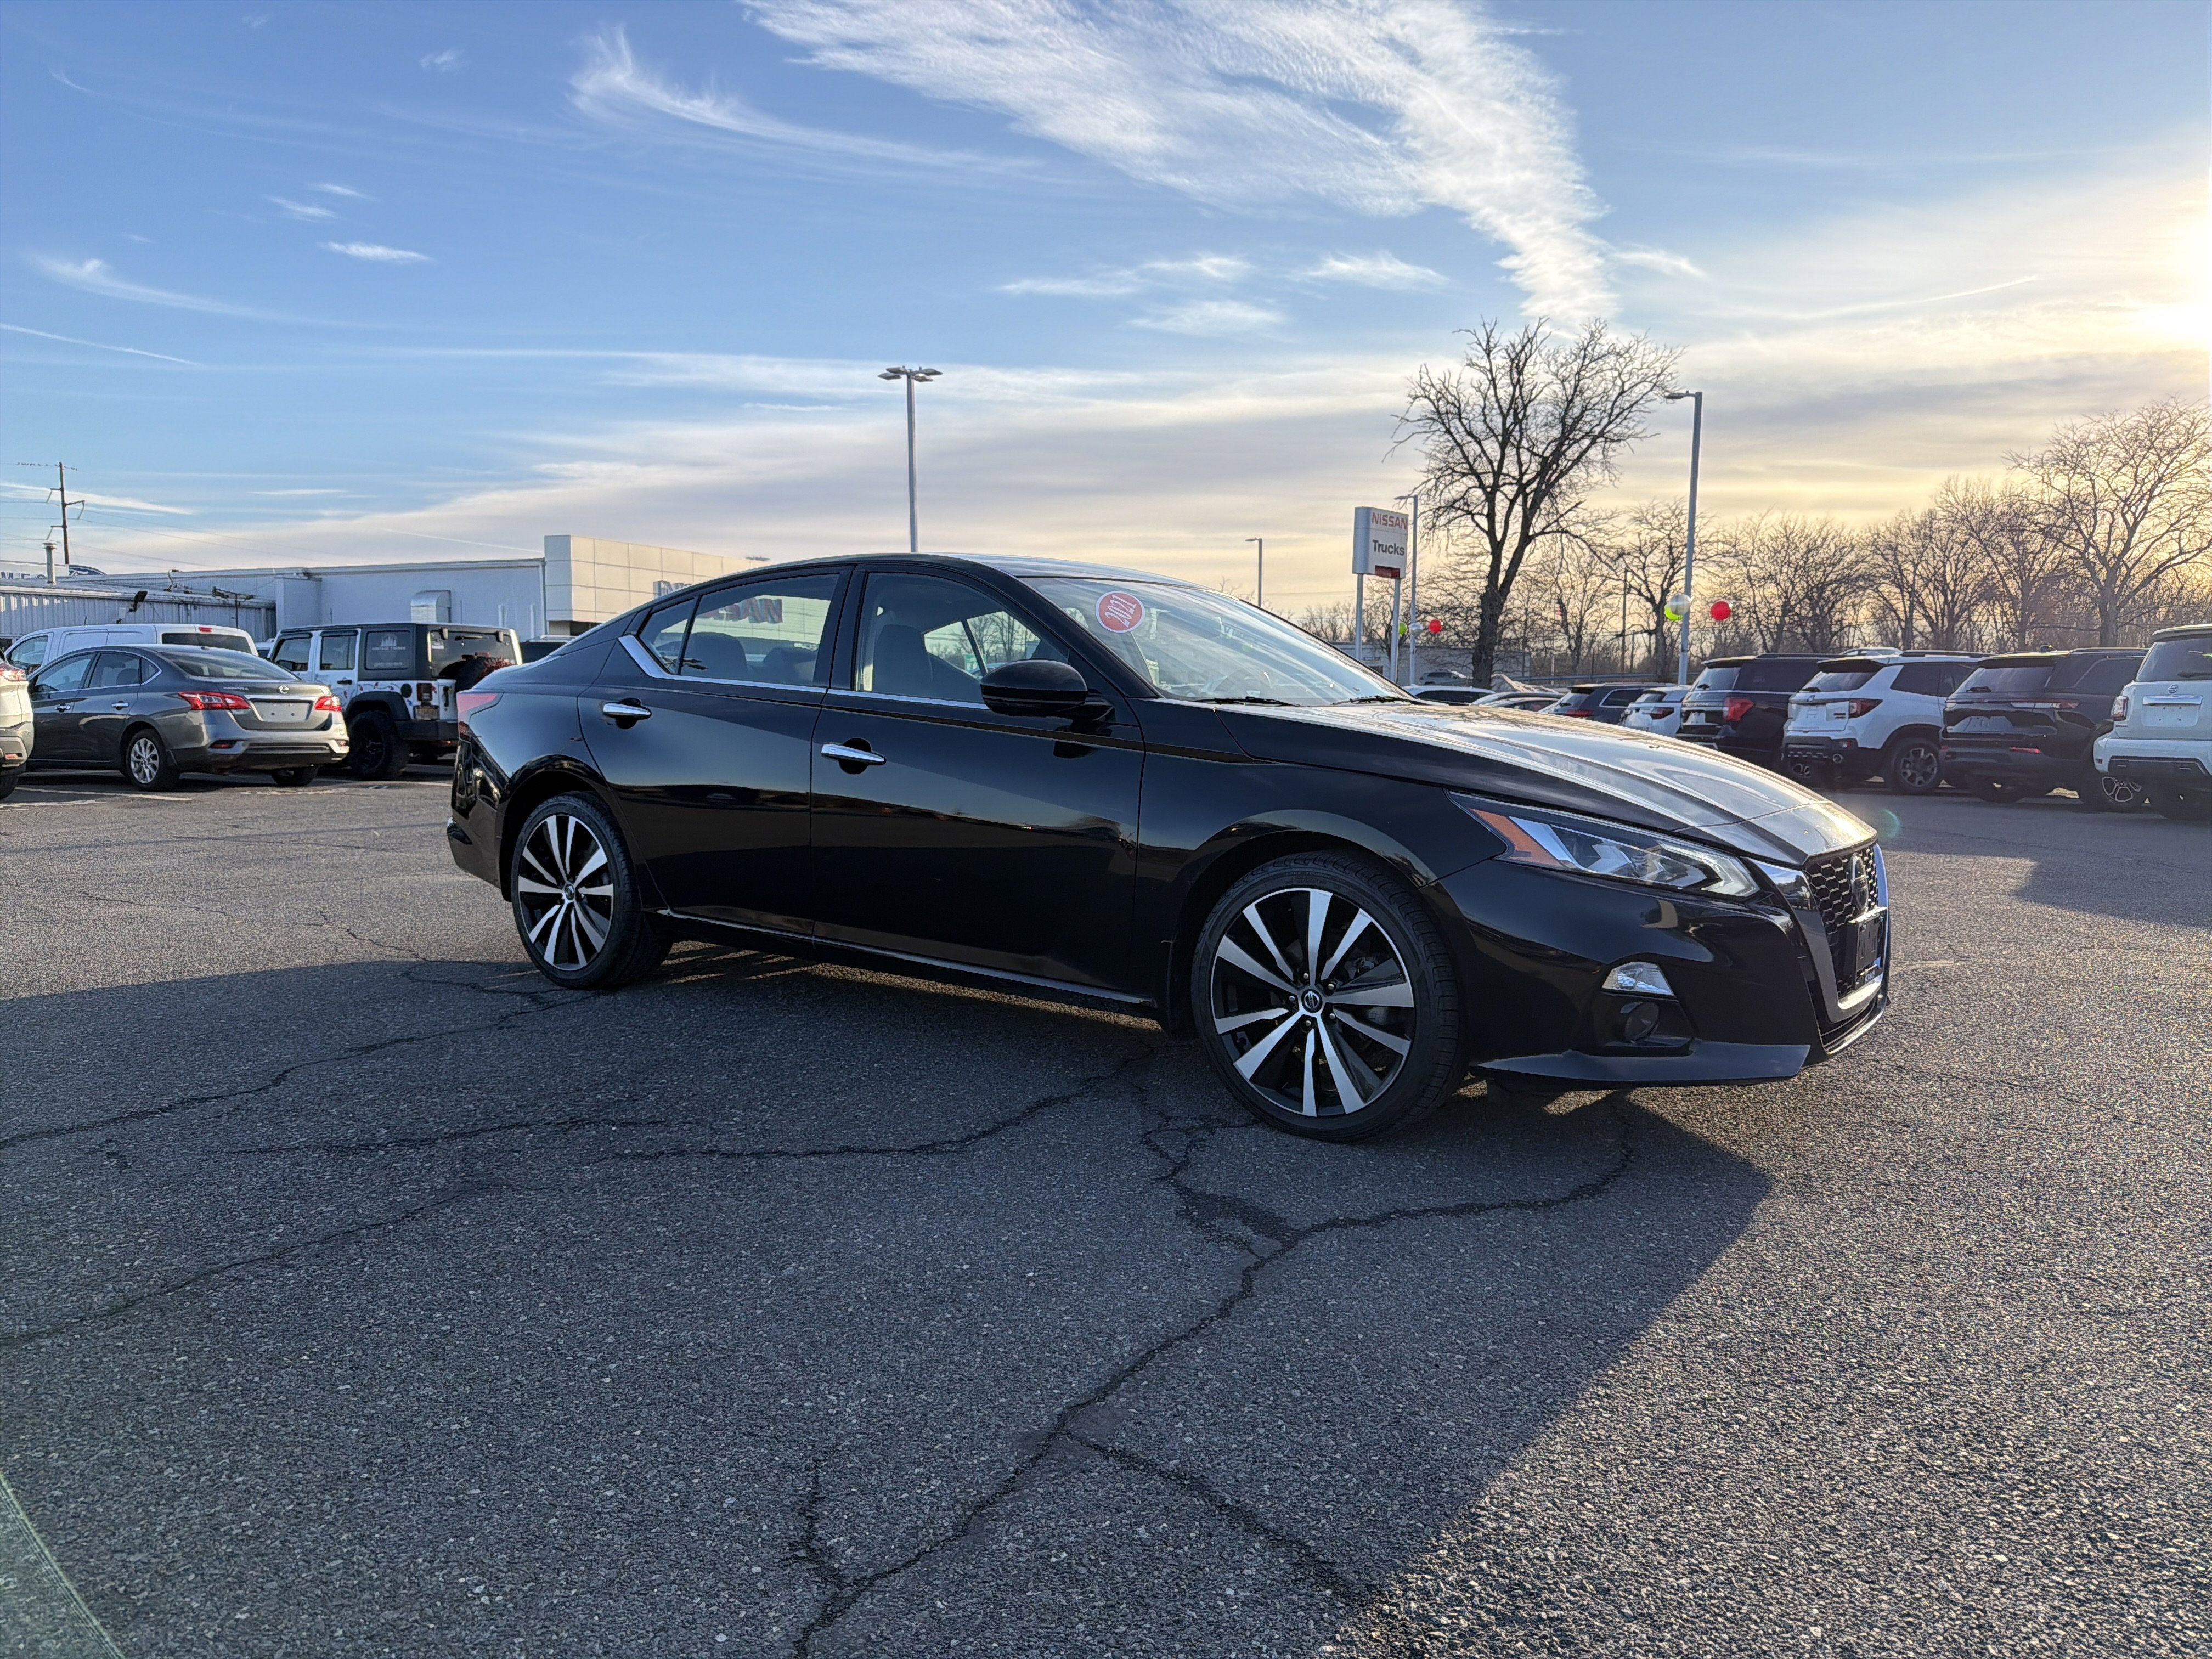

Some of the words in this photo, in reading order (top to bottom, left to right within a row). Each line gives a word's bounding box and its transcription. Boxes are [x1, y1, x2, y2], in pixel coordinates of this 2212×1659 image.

[1372, 512, 1408, 530] NISSAN
[1372, 539, 1405, 556] Trucks
[1105, 595, 1137, 628] 2021
